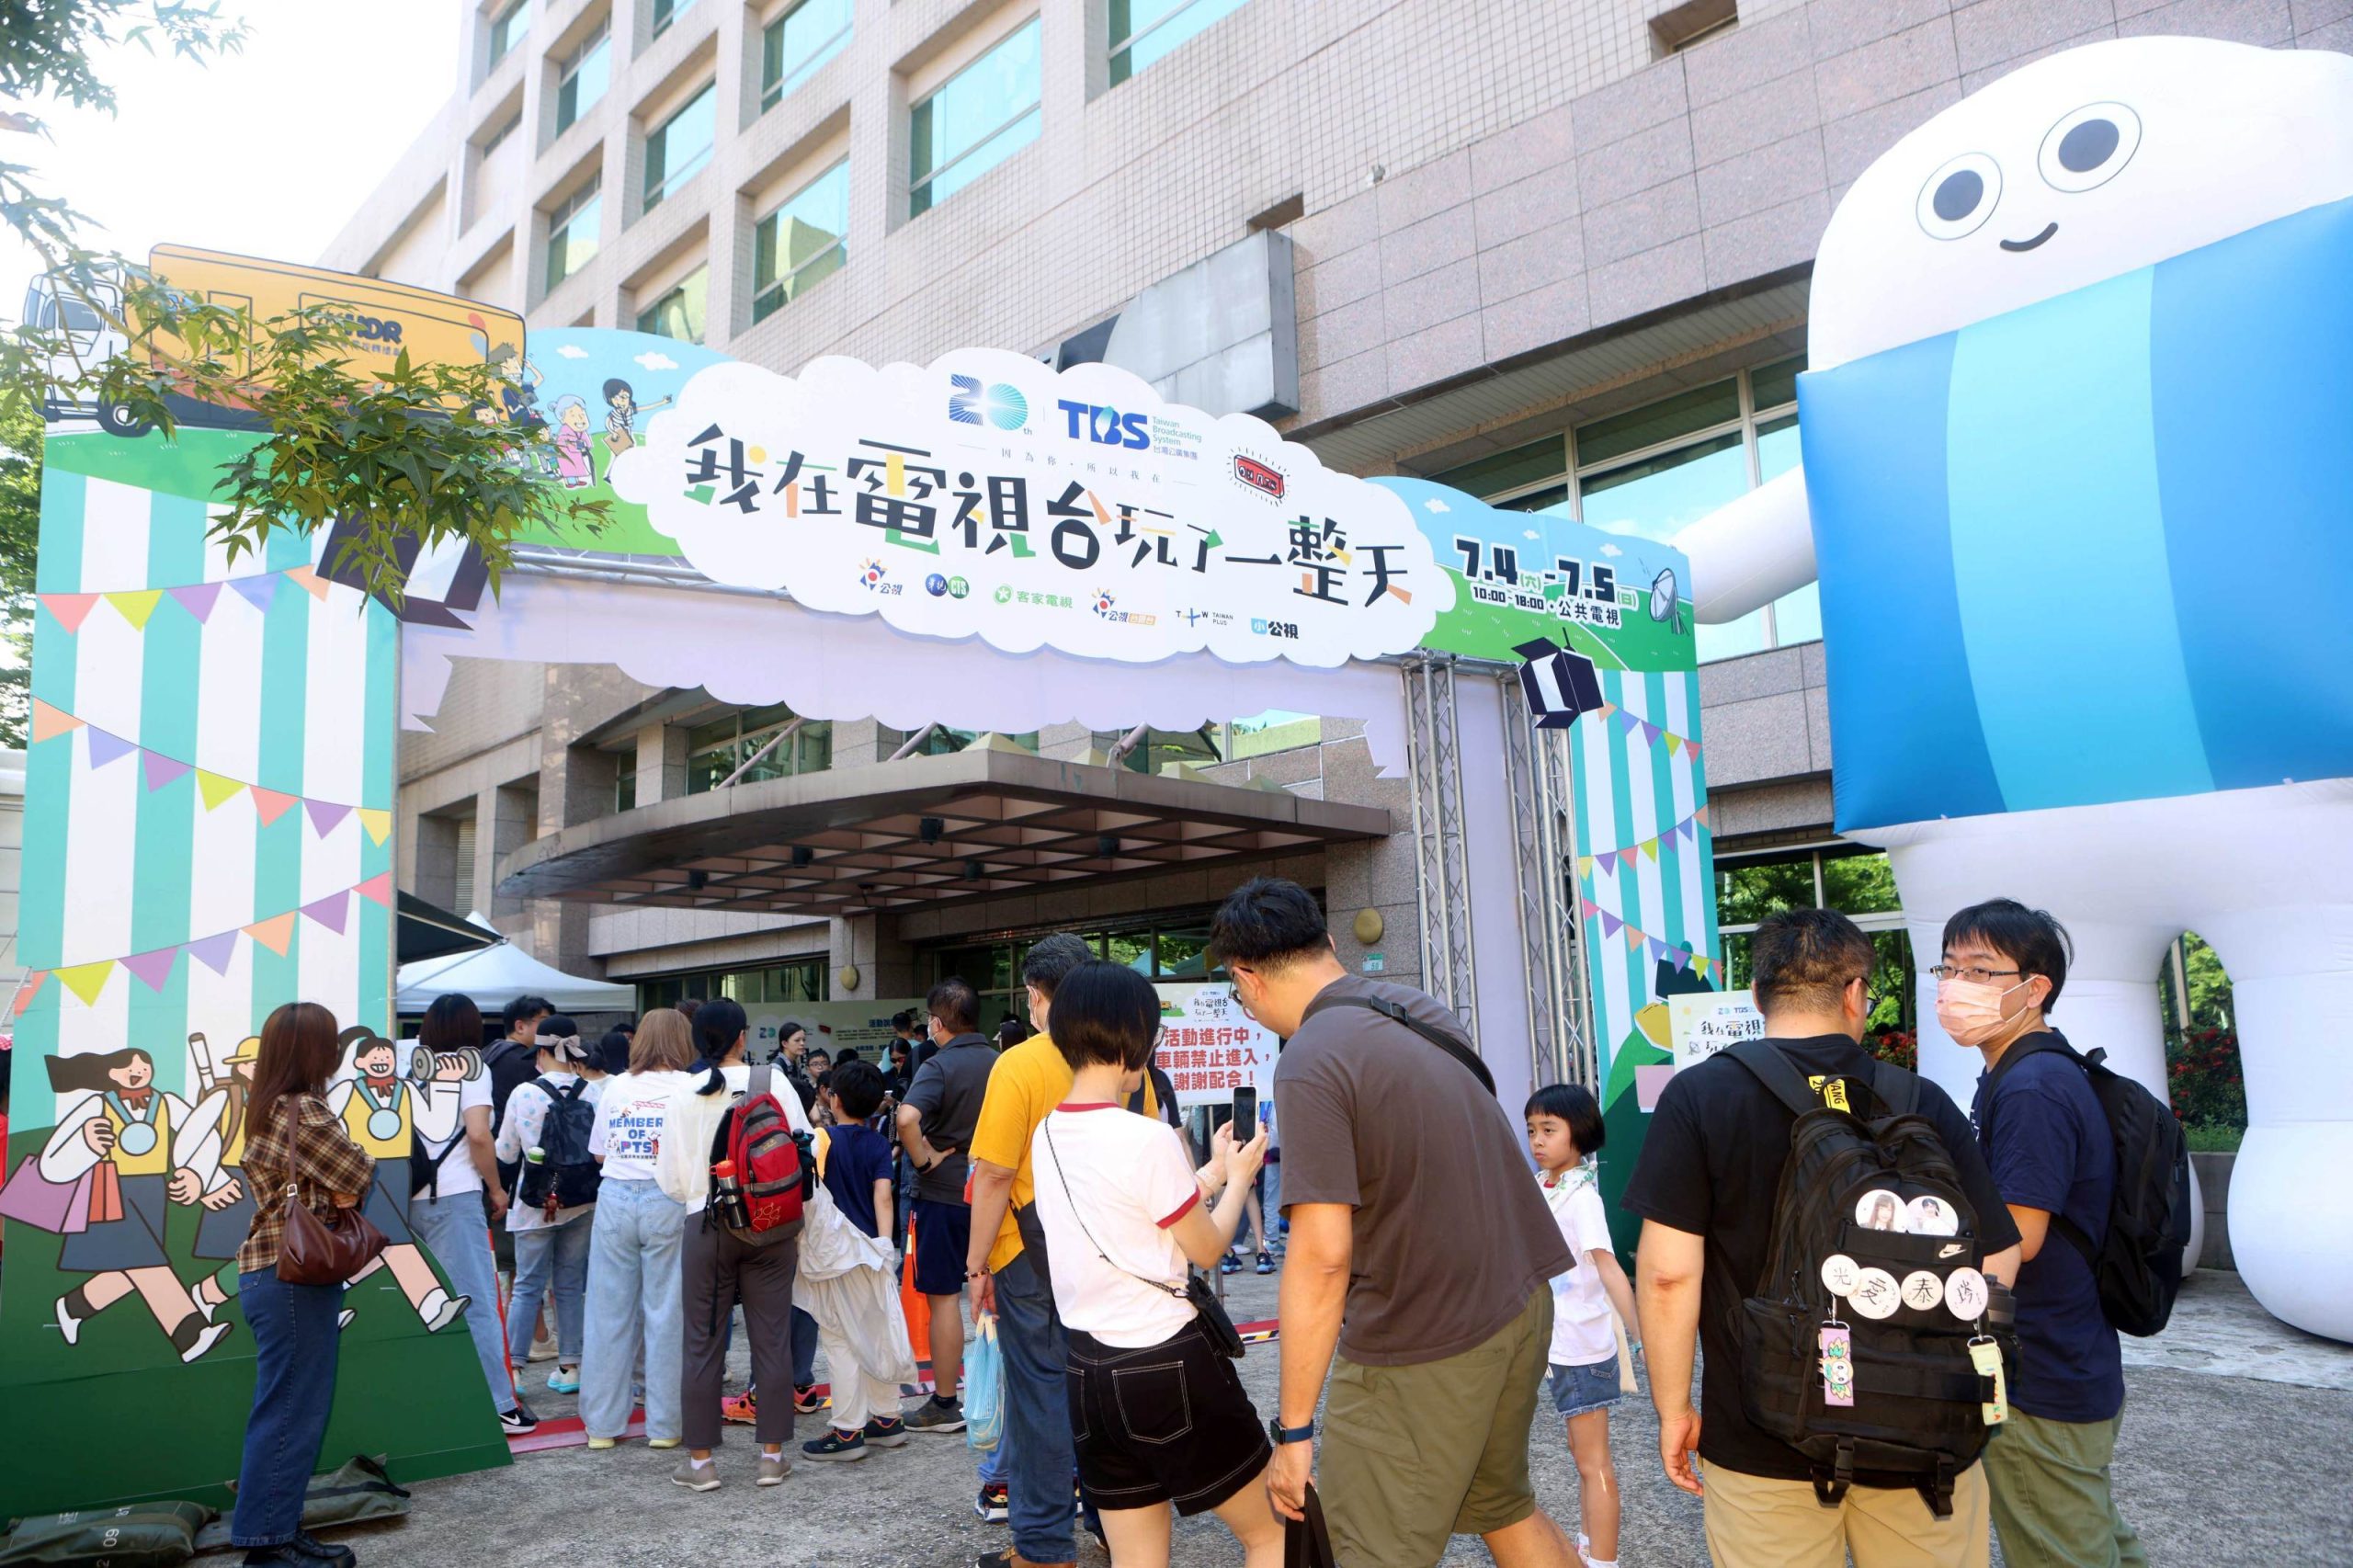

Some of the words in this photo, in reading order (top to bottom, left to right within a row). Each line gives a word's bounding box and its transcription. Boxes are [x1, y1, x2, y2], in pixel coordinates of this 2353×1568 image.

[1058, 399, 1151, 451] TBS
[1153, 415, 1180, 429] Taiwan
[1153, 425, 1202, 444] Broadcasting
[1153, 434, 1182, 447] System
[684, 423, 1412, 607] 我在電視台玩了一整天
[880, 582, 903, 596] 公視
[950, 579, 967, 596] CTS
[1017, 590, 1074, 608] 客家電視
[1212, 612, 1233, 620] TAIWAN
[1559, 600, 1620, 626] 公共電視
[1701, 1019, 1765, 1039] 我在電視
[609, 1117, 664, 1129] MEMBER
[628, 1129, 646, 1140] OF
[620, 1141, 653, 1153] PTS
[1912, 1278, 1935, 1303] 泰
